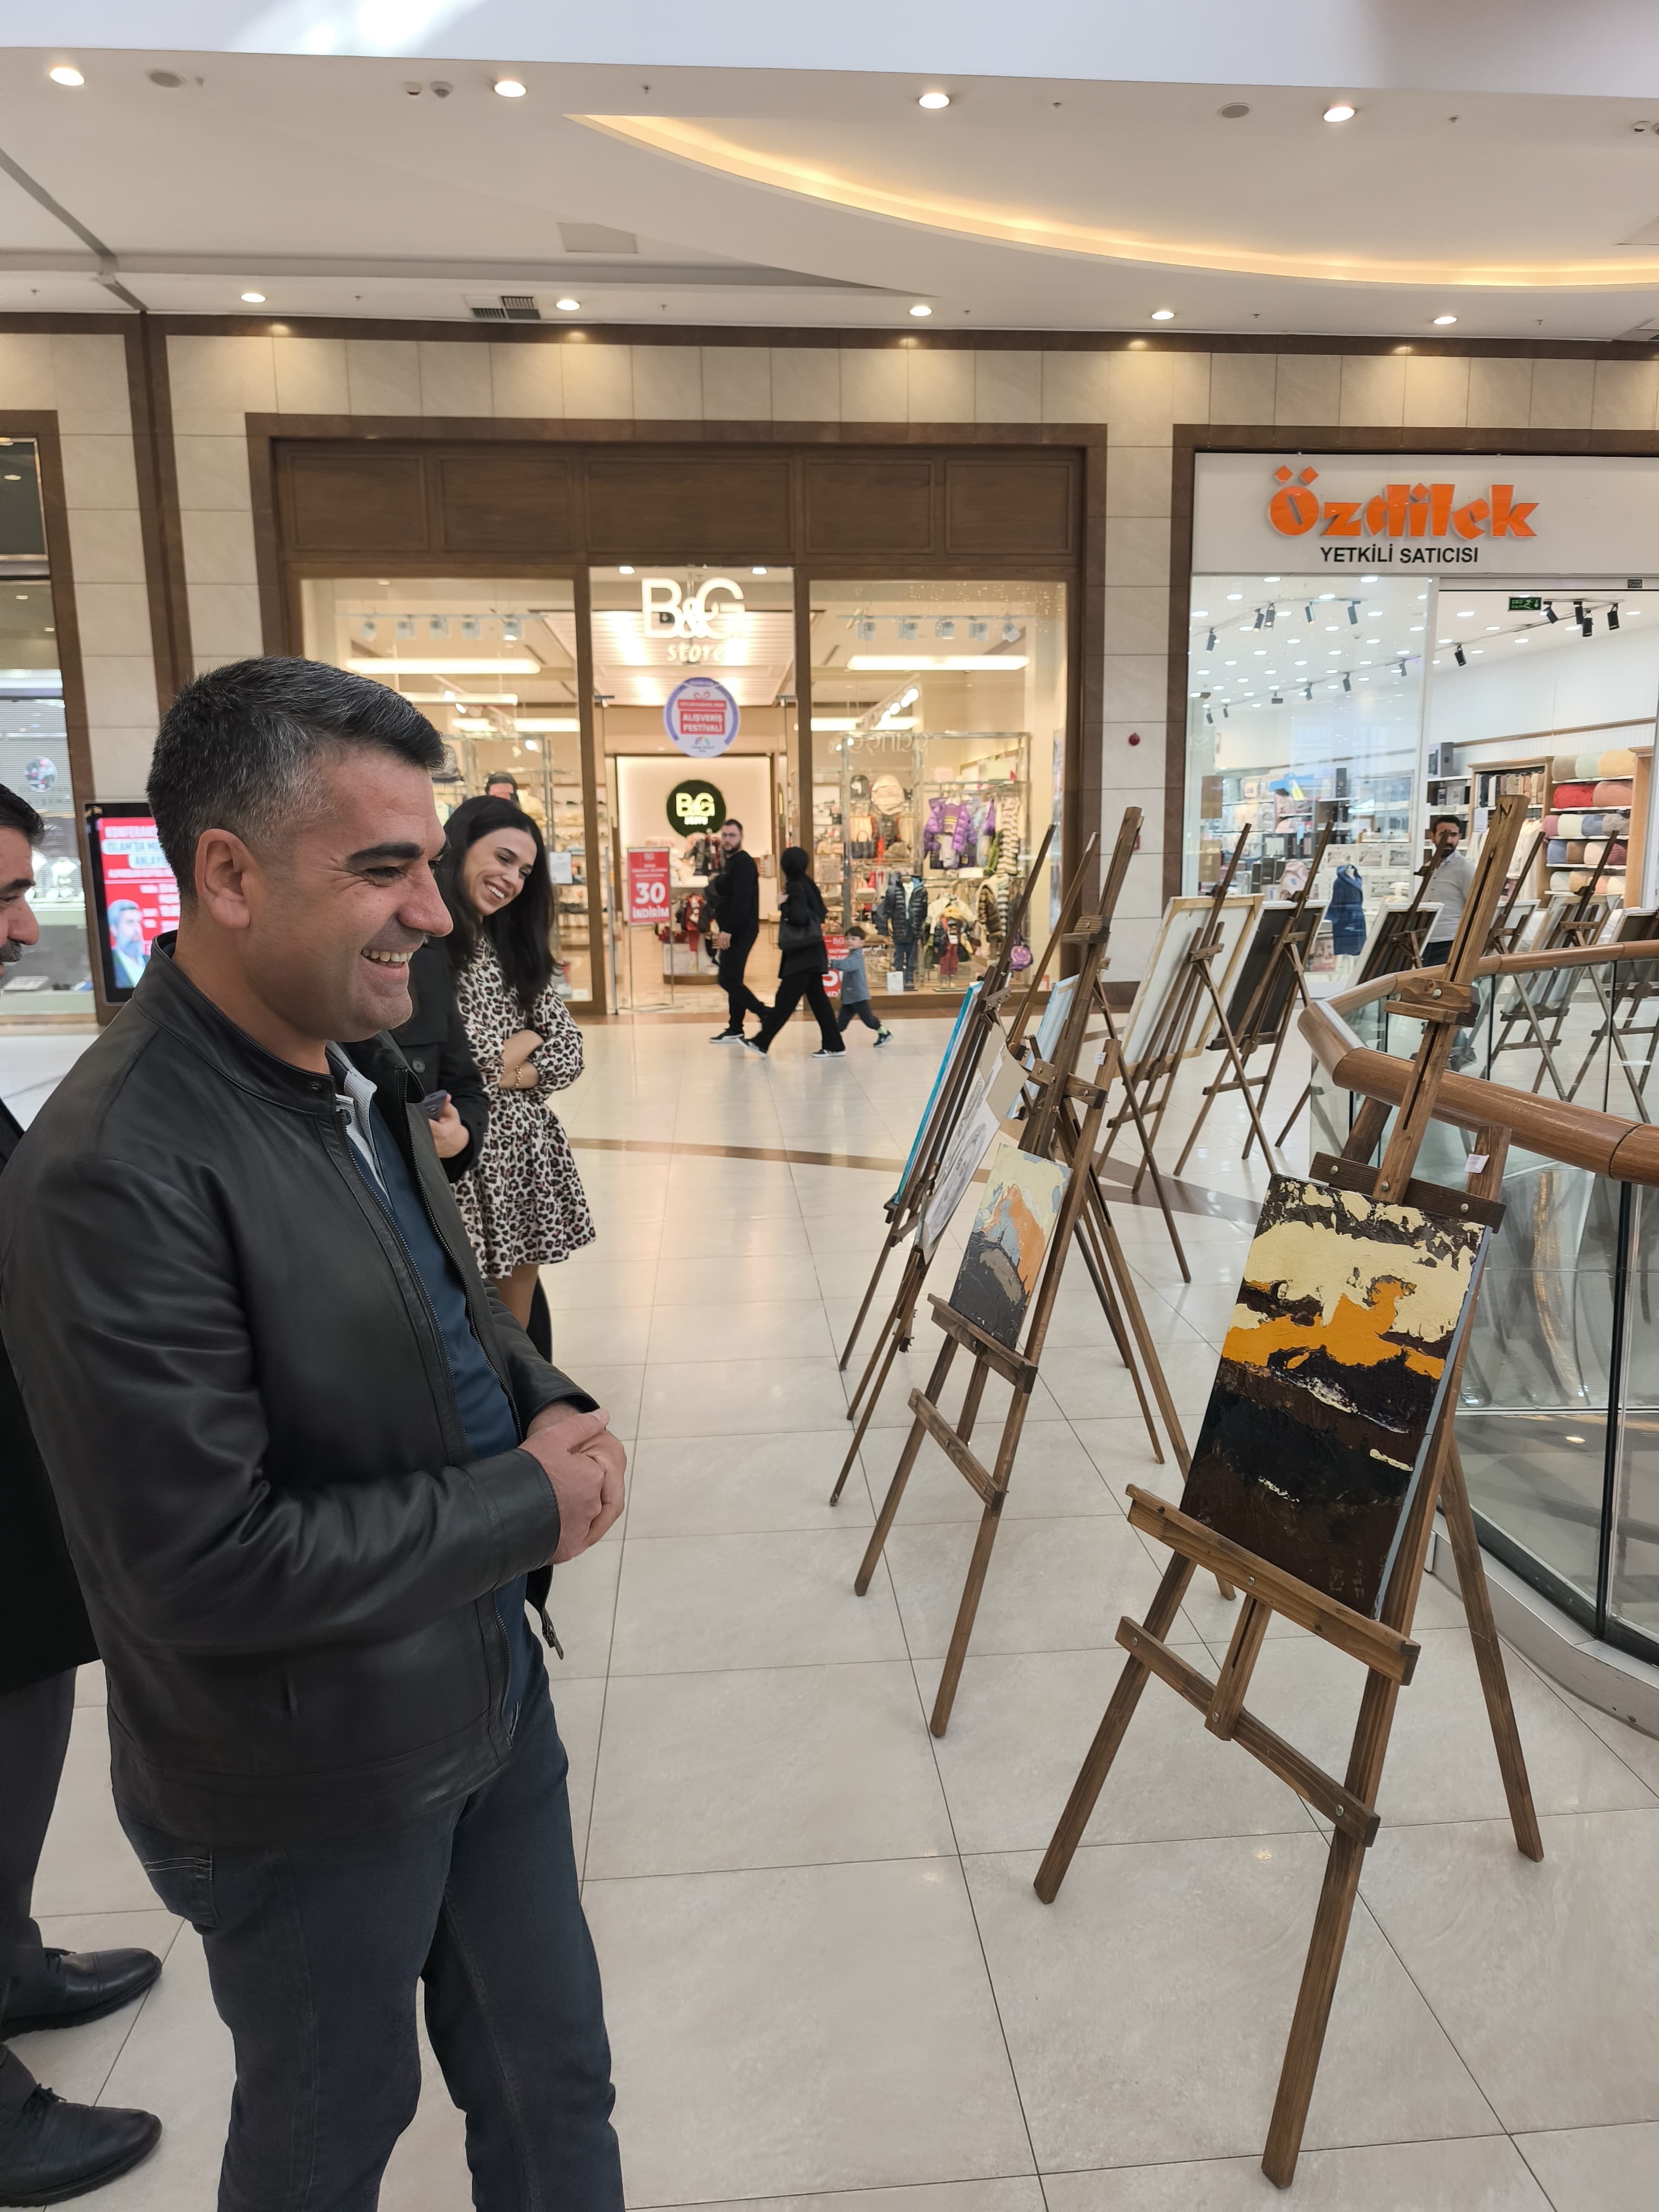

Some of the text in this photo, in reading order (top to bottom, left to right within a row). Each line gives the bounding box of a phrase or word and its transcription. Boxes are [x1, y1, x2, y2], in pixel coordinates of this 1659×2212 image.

[1269, 465, 1540, 540] Özdilek
[1320, 543, 1479, 563] YETKİLİ SATICISI
[641, 576, 746, 640] B&G
[666, 642, 725, 663] store
[682, 713, 723, 723] ALIŞVERİŞ
[682, 723, 723, 733] FESTİVALİ
[635, 881, 666, 905] 30
[632, 905, 670, 919] İNDİRİM
